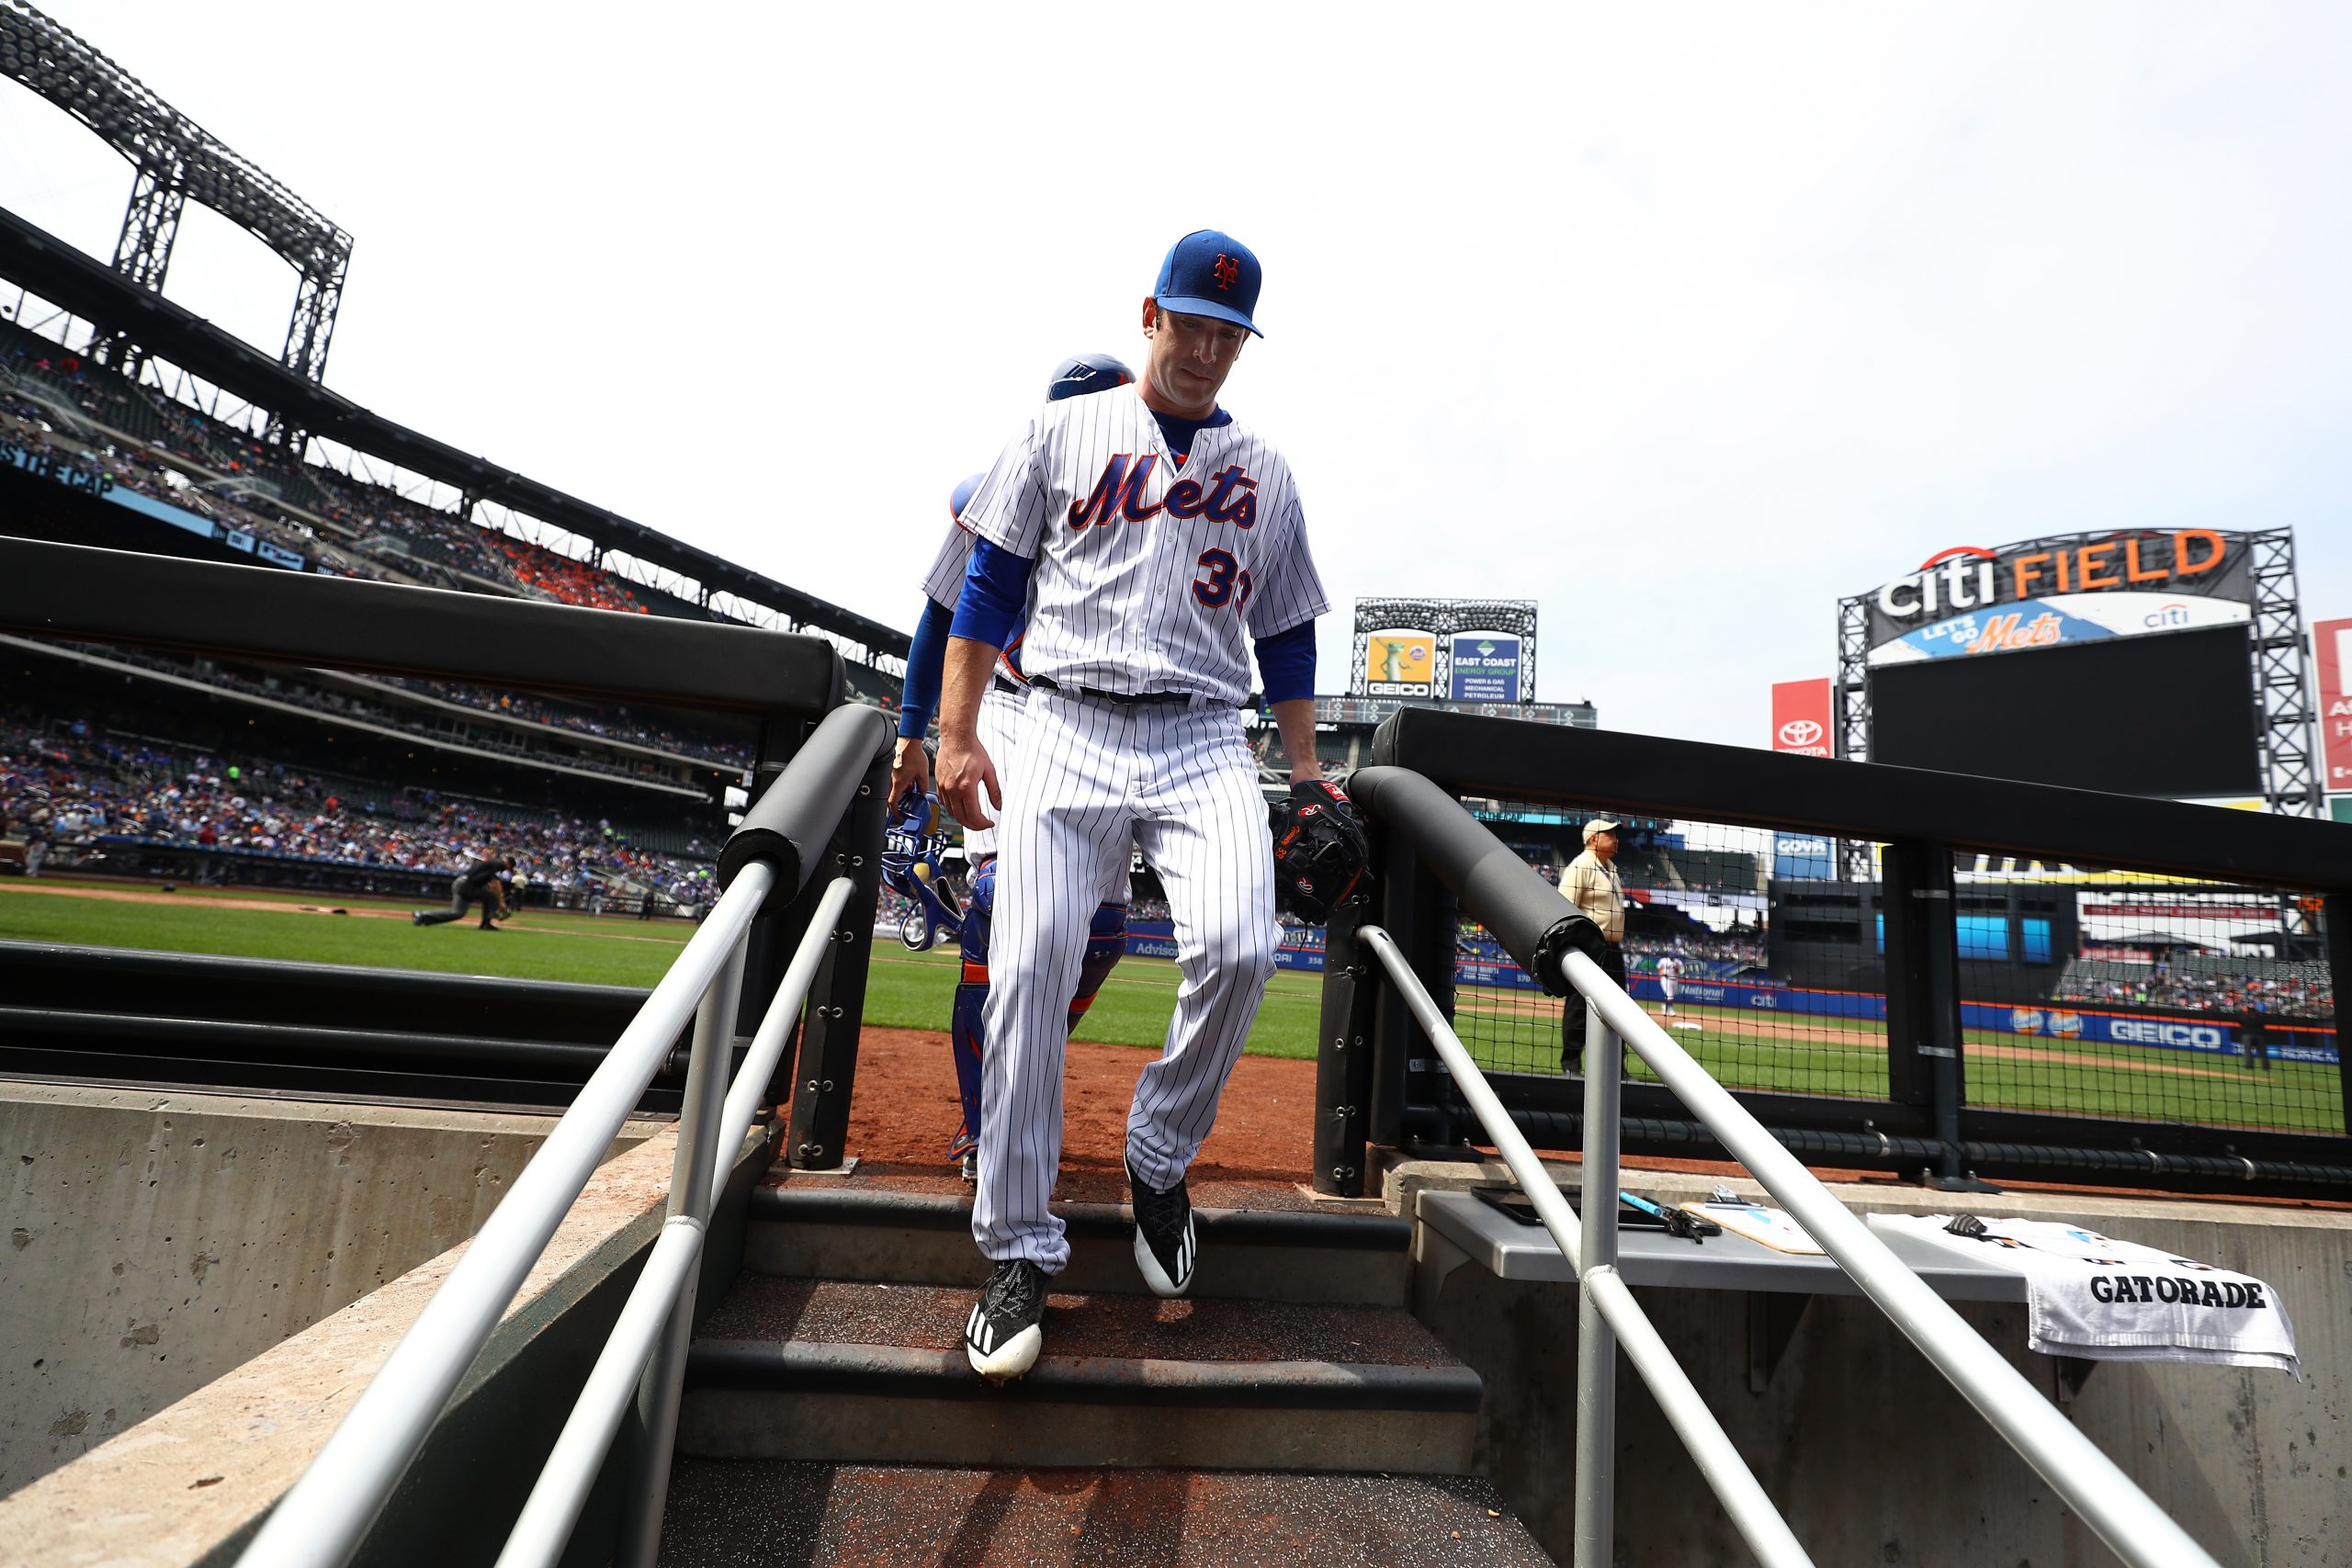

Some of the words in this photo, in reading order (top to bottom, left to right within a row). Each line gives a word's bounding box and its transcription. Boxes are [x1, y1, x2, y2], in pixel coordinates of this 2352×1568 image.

[1067, 453, 1259, 531] Mets
[1877, 556, 1996, 617] citi
[2012, 529, 2227, 599] FIELD
[2143, 608, 2188, 628] citi
[1922, 615, 1976, 640] LET'S
[1951, 626, 1980, 643] GO
[1965, 612, 2064, 653] Mets
[1454, 657, 1481, 666] EAST
[1482, 658, 1517, 667] COAST
[1454, 667, 1487, 675] ENERGY
[1488, 668, 1516, 676] GROUP
[1369, 682, 1429, 696] GEICO
[1778, 746, 1828, 757] OYOTA
[1778, 838, 1826, 853] GOYA
[1680, 984, 1724, 998] National
[2109, 1019, 2222, 1049] GEICO
[2090, 1275, 2267, 1309] GATORADE
